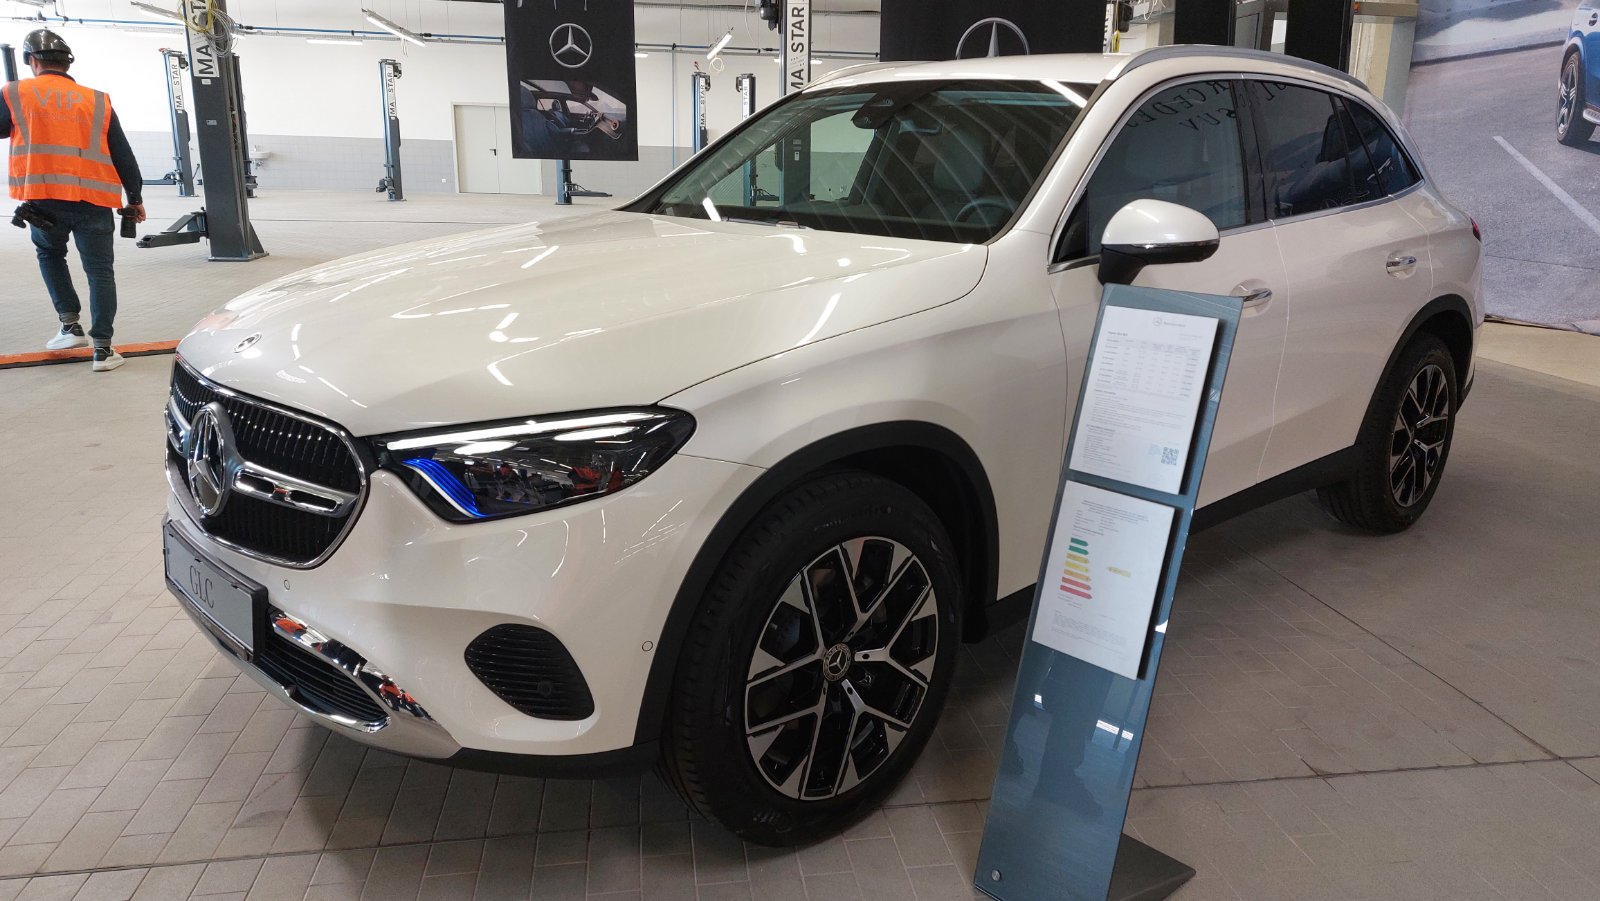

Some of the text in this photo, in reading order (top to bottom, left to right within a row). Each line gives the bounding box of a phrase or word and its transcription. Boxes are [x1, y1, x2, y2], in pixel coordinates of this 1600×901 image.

[791, 6, 805, 53] STAR
[171, 64, 180, 86] STAR
[195, 44, 214, 75] MA
[32, 86, 83, 111] VIP
[189, 565, 215, 609] GLC
